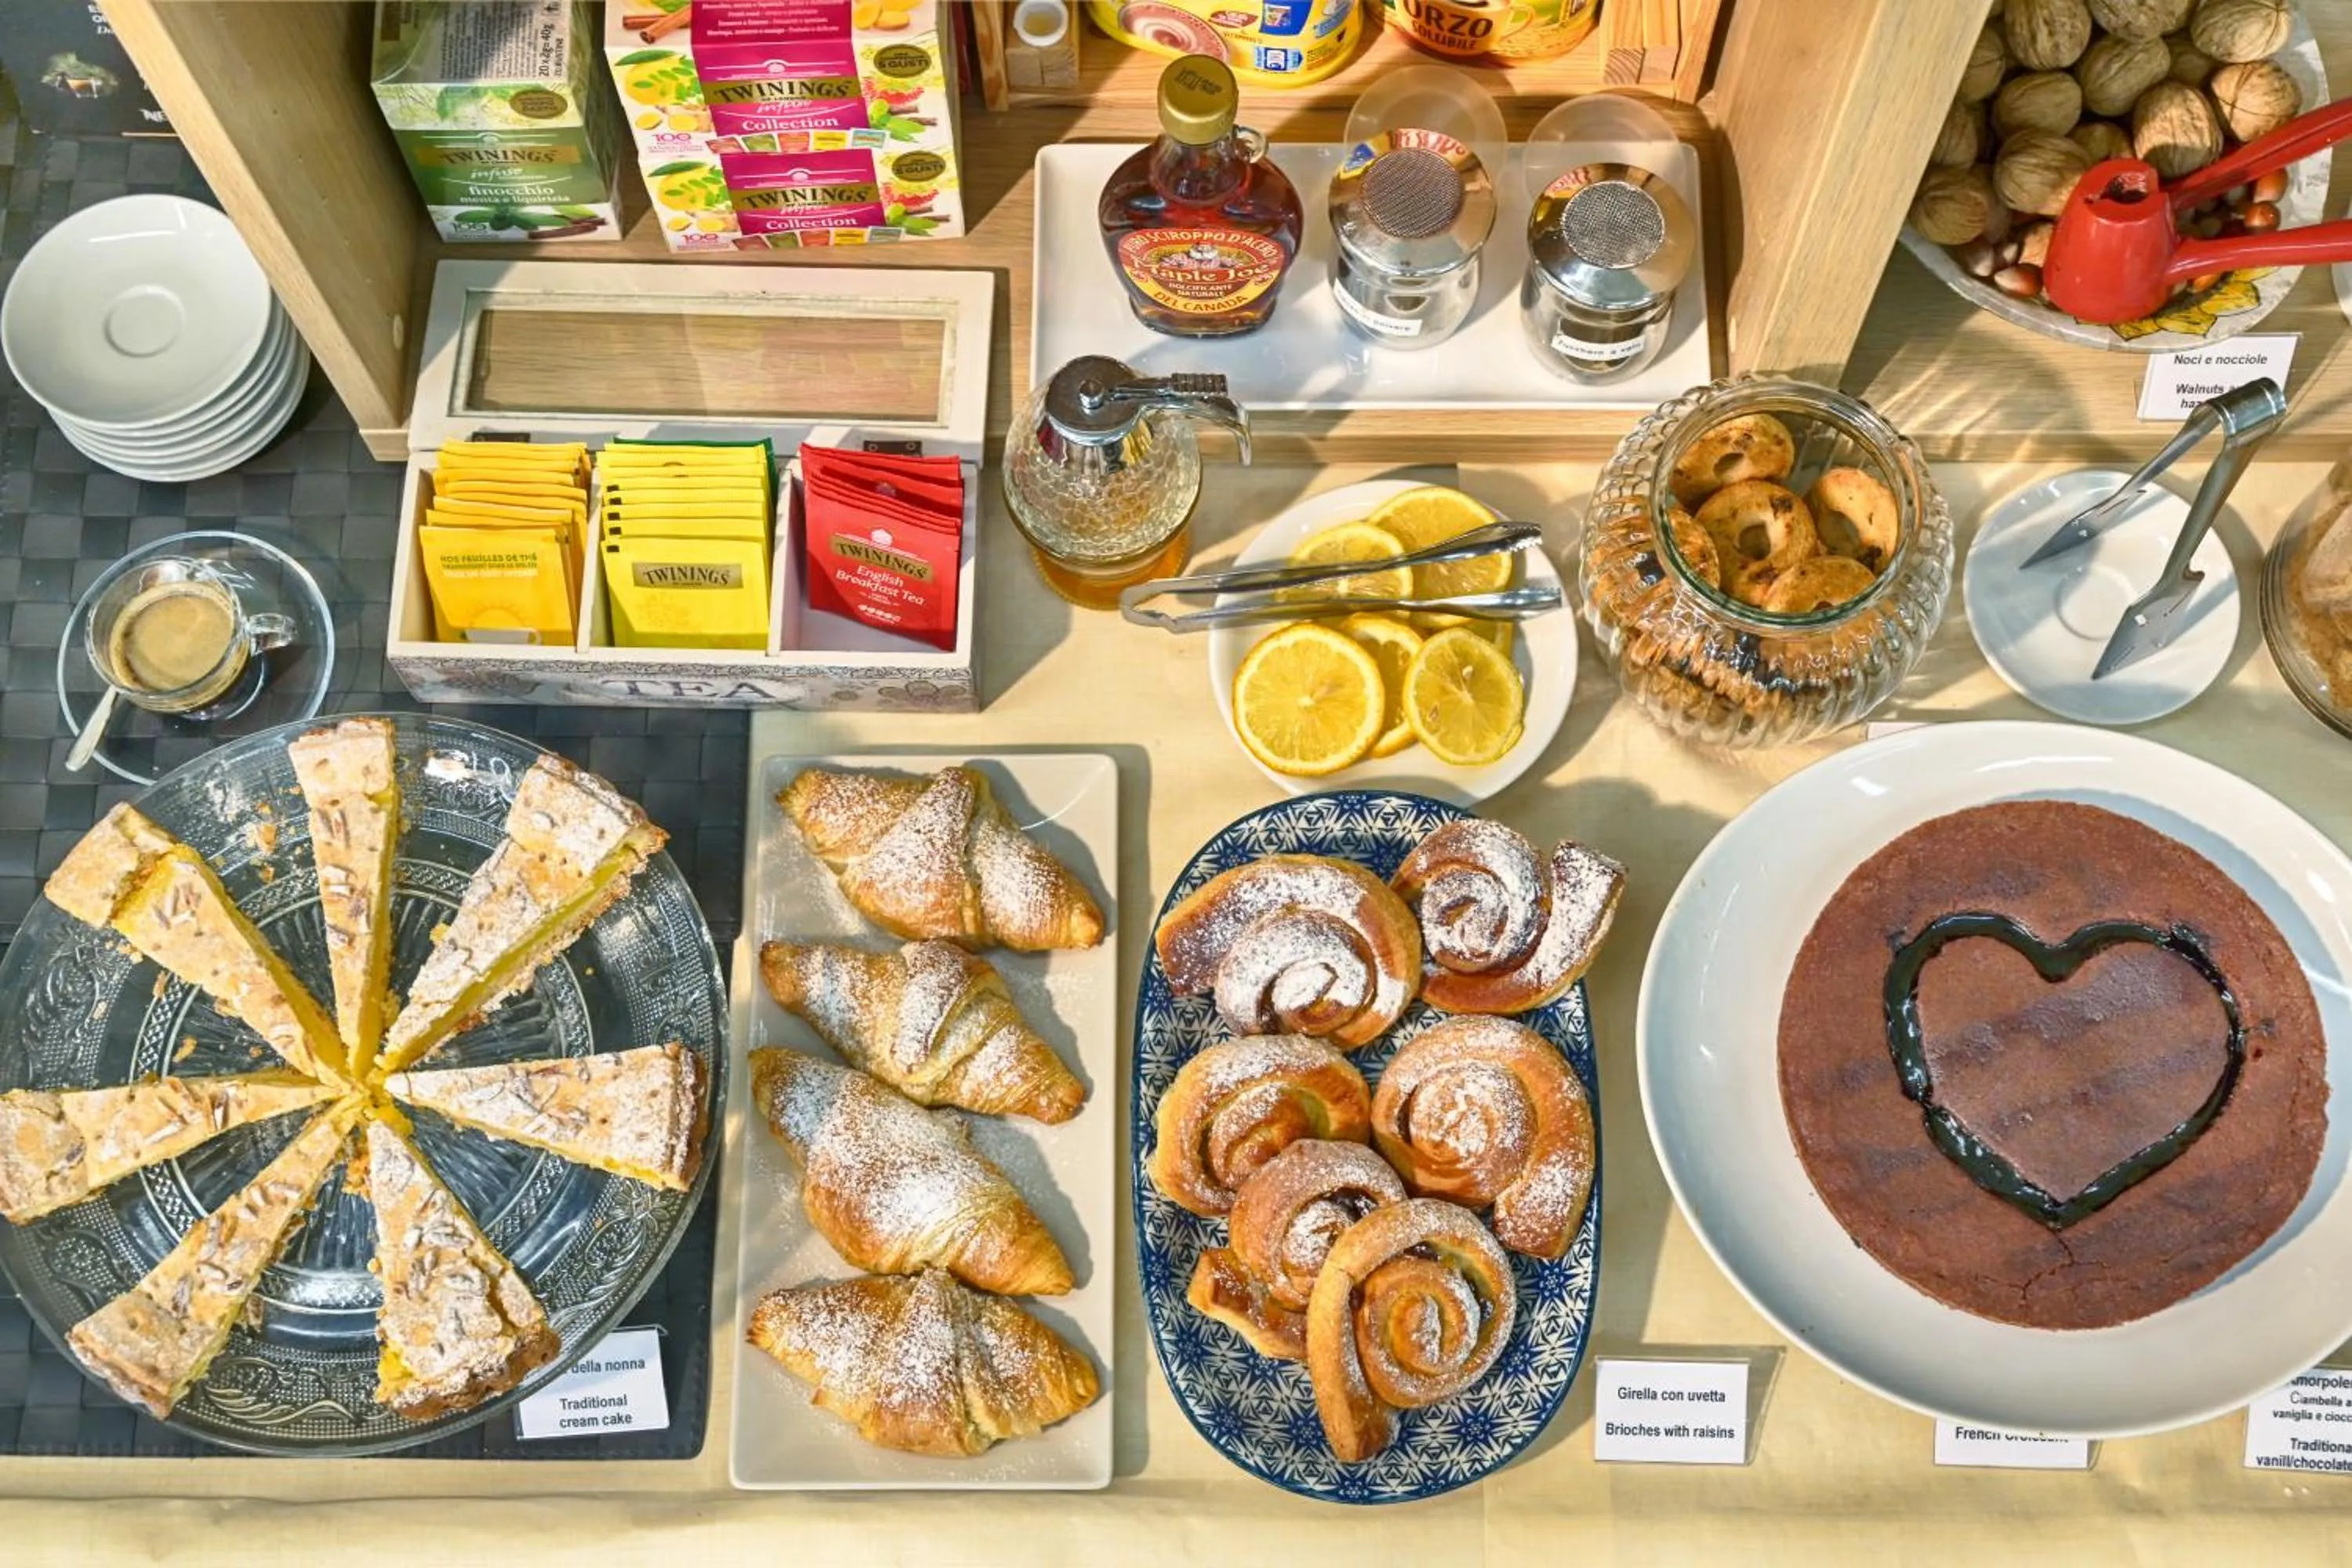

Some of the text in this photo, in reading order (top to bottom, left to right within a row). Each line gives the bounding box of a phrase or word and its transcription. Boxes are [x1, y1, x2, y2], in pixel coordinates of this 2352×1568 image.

[1403, 0, 1494, 38] ORZO
[1412, 20, 1475, 50] SOLUBILE
[713, 81, 851, 103] TWININGS
[742, 117, 840, 131] Collection
[439, 148, 556, 165] TWININGS
[469, 185, 555, 195] finocchio
[742, 187, 869, 209] TWININGS
[766, 217, 858, 230] Collection
[1148, 230, 1225, 243] SCIROPPO
[1229, 233, 1279, 259] D'ACERO
[1224, 264, 1269, 281] Joe
[1168, 282, 1232, 291] DOLCIFICANTE
[1153, 291, 1249, 312] DEL CANADA
[2173, 354, 2201, 365] Noci
[2216, 354, 2268, 365] nocciole
[2176, 383, 2224, 394] Walnuts
[836, 543, 928, 579] TWININGS
[643, 566, 729, 586] TWININGS
[857, 564, 904, 587] English
[836, 569, 899, 597] Breakfast
[902, 590, 924, 605] Tea
[601, 680, 778, 699] TEA
[604, 1359, 646, 1372] nonna
[559, 1394, 628, 1411] Traditional
[1617, 1387, 1726, 1403] Girella con uvetta
[559, 1414, 633, 1428] cream cake
[2272, 1409, 2313, 1421] vaniglia
[2315, 1412, 2322, 1421] e
[1606, 1423, 1735, 1439] Brioches with raisins
